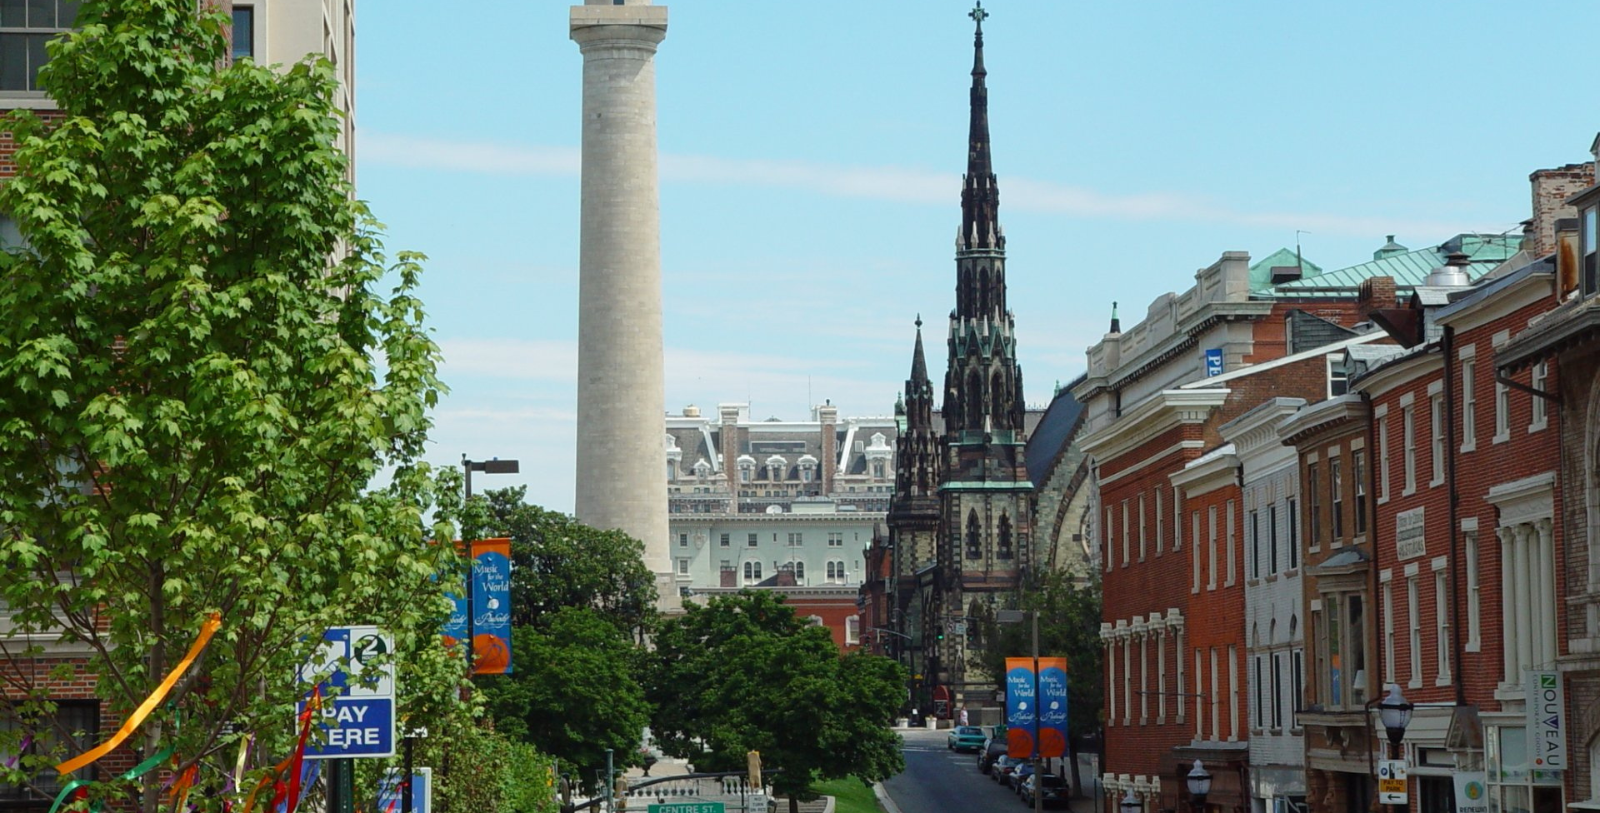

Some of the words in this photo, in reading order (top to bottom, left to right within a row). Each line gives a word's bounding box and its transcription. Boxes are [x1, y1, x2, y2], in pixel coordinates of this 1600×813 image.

[474, 565, 498, 575] Music
[482, 582, 509, 592] World
[1014, 689, 1034, 697] World
[1046, 689, 1066, 697] World
[1532, 674, 1540, 729] CONTEMPORARY
[1541, 674, 1560, 766] NOUVEAU
[312, 728, 380, 745] ERE
[659, 805, 699, 813] CENTRE
